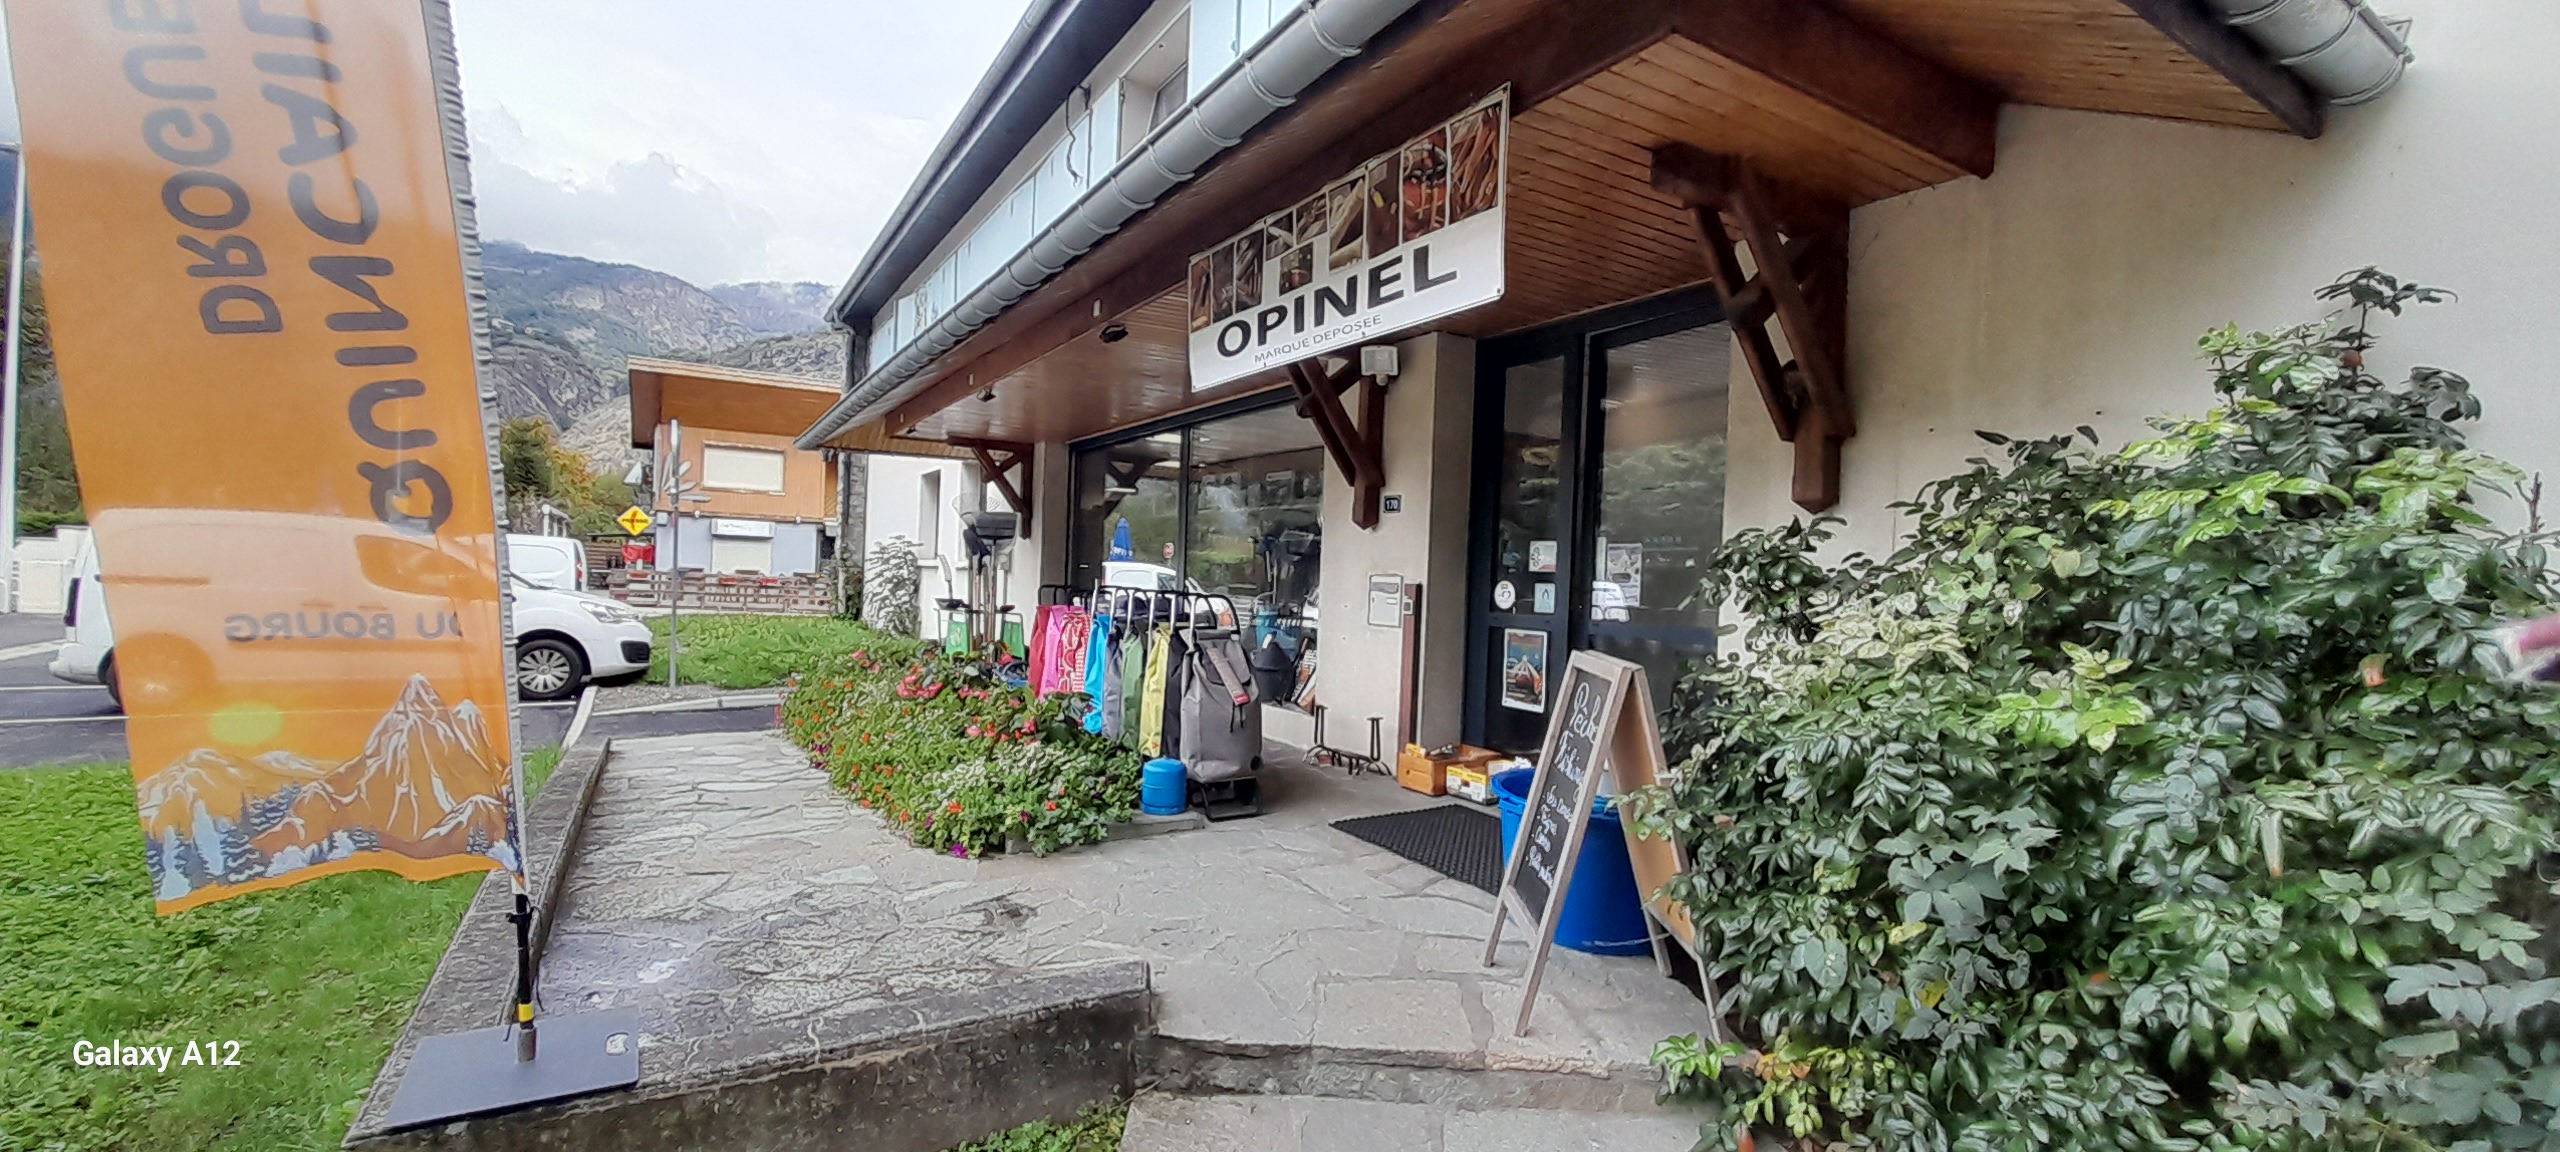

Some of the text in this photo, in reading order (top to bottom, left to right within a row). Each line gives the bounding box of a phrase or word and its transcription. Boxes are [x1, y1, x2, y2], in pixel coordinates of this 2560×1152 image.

[1216, 243, 1458, 359] OPINEL
[1253, 313, 1383, 364] MARQUE DEPOSEE
[1386, 500, 1398, 510] 170
